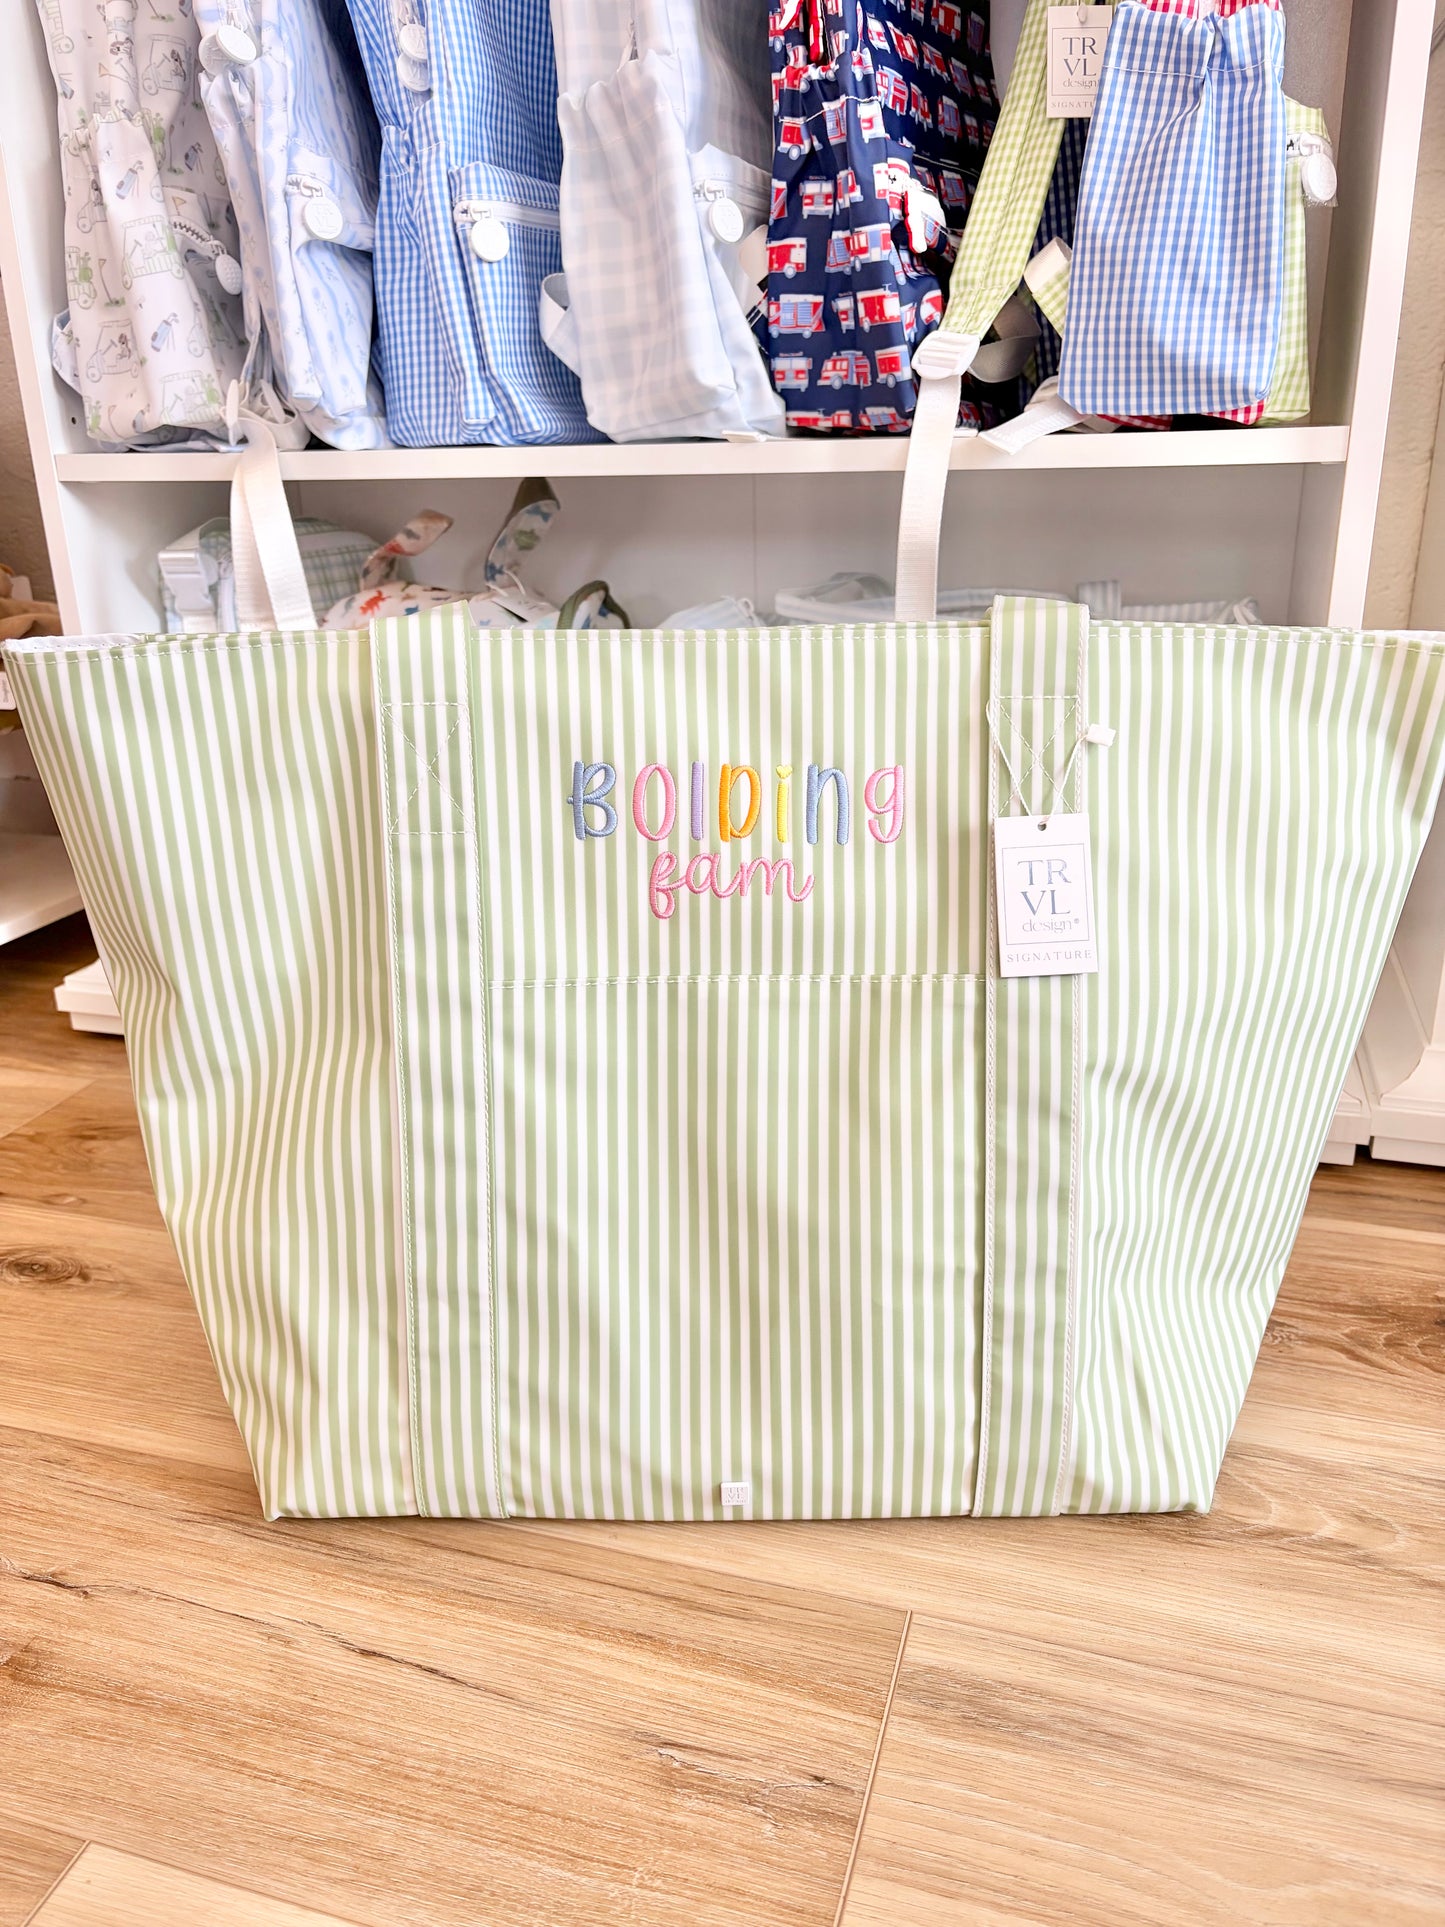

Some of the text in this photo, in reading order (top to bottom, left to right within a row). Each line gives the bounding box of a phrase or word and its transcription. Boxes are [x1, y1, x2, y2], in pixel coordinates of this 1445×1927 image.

[1062, 37, 1098, 55] TR
[1064, 58, 1097, 76] VL
[1062, 78, 1097, 89] design
[1017, 858, 1072, 885] TR
[649, 851, 815, 919] fam
[1020, 889, 1071, 916] VL
[1007, 949, 1092, 963] SIGNATURE
